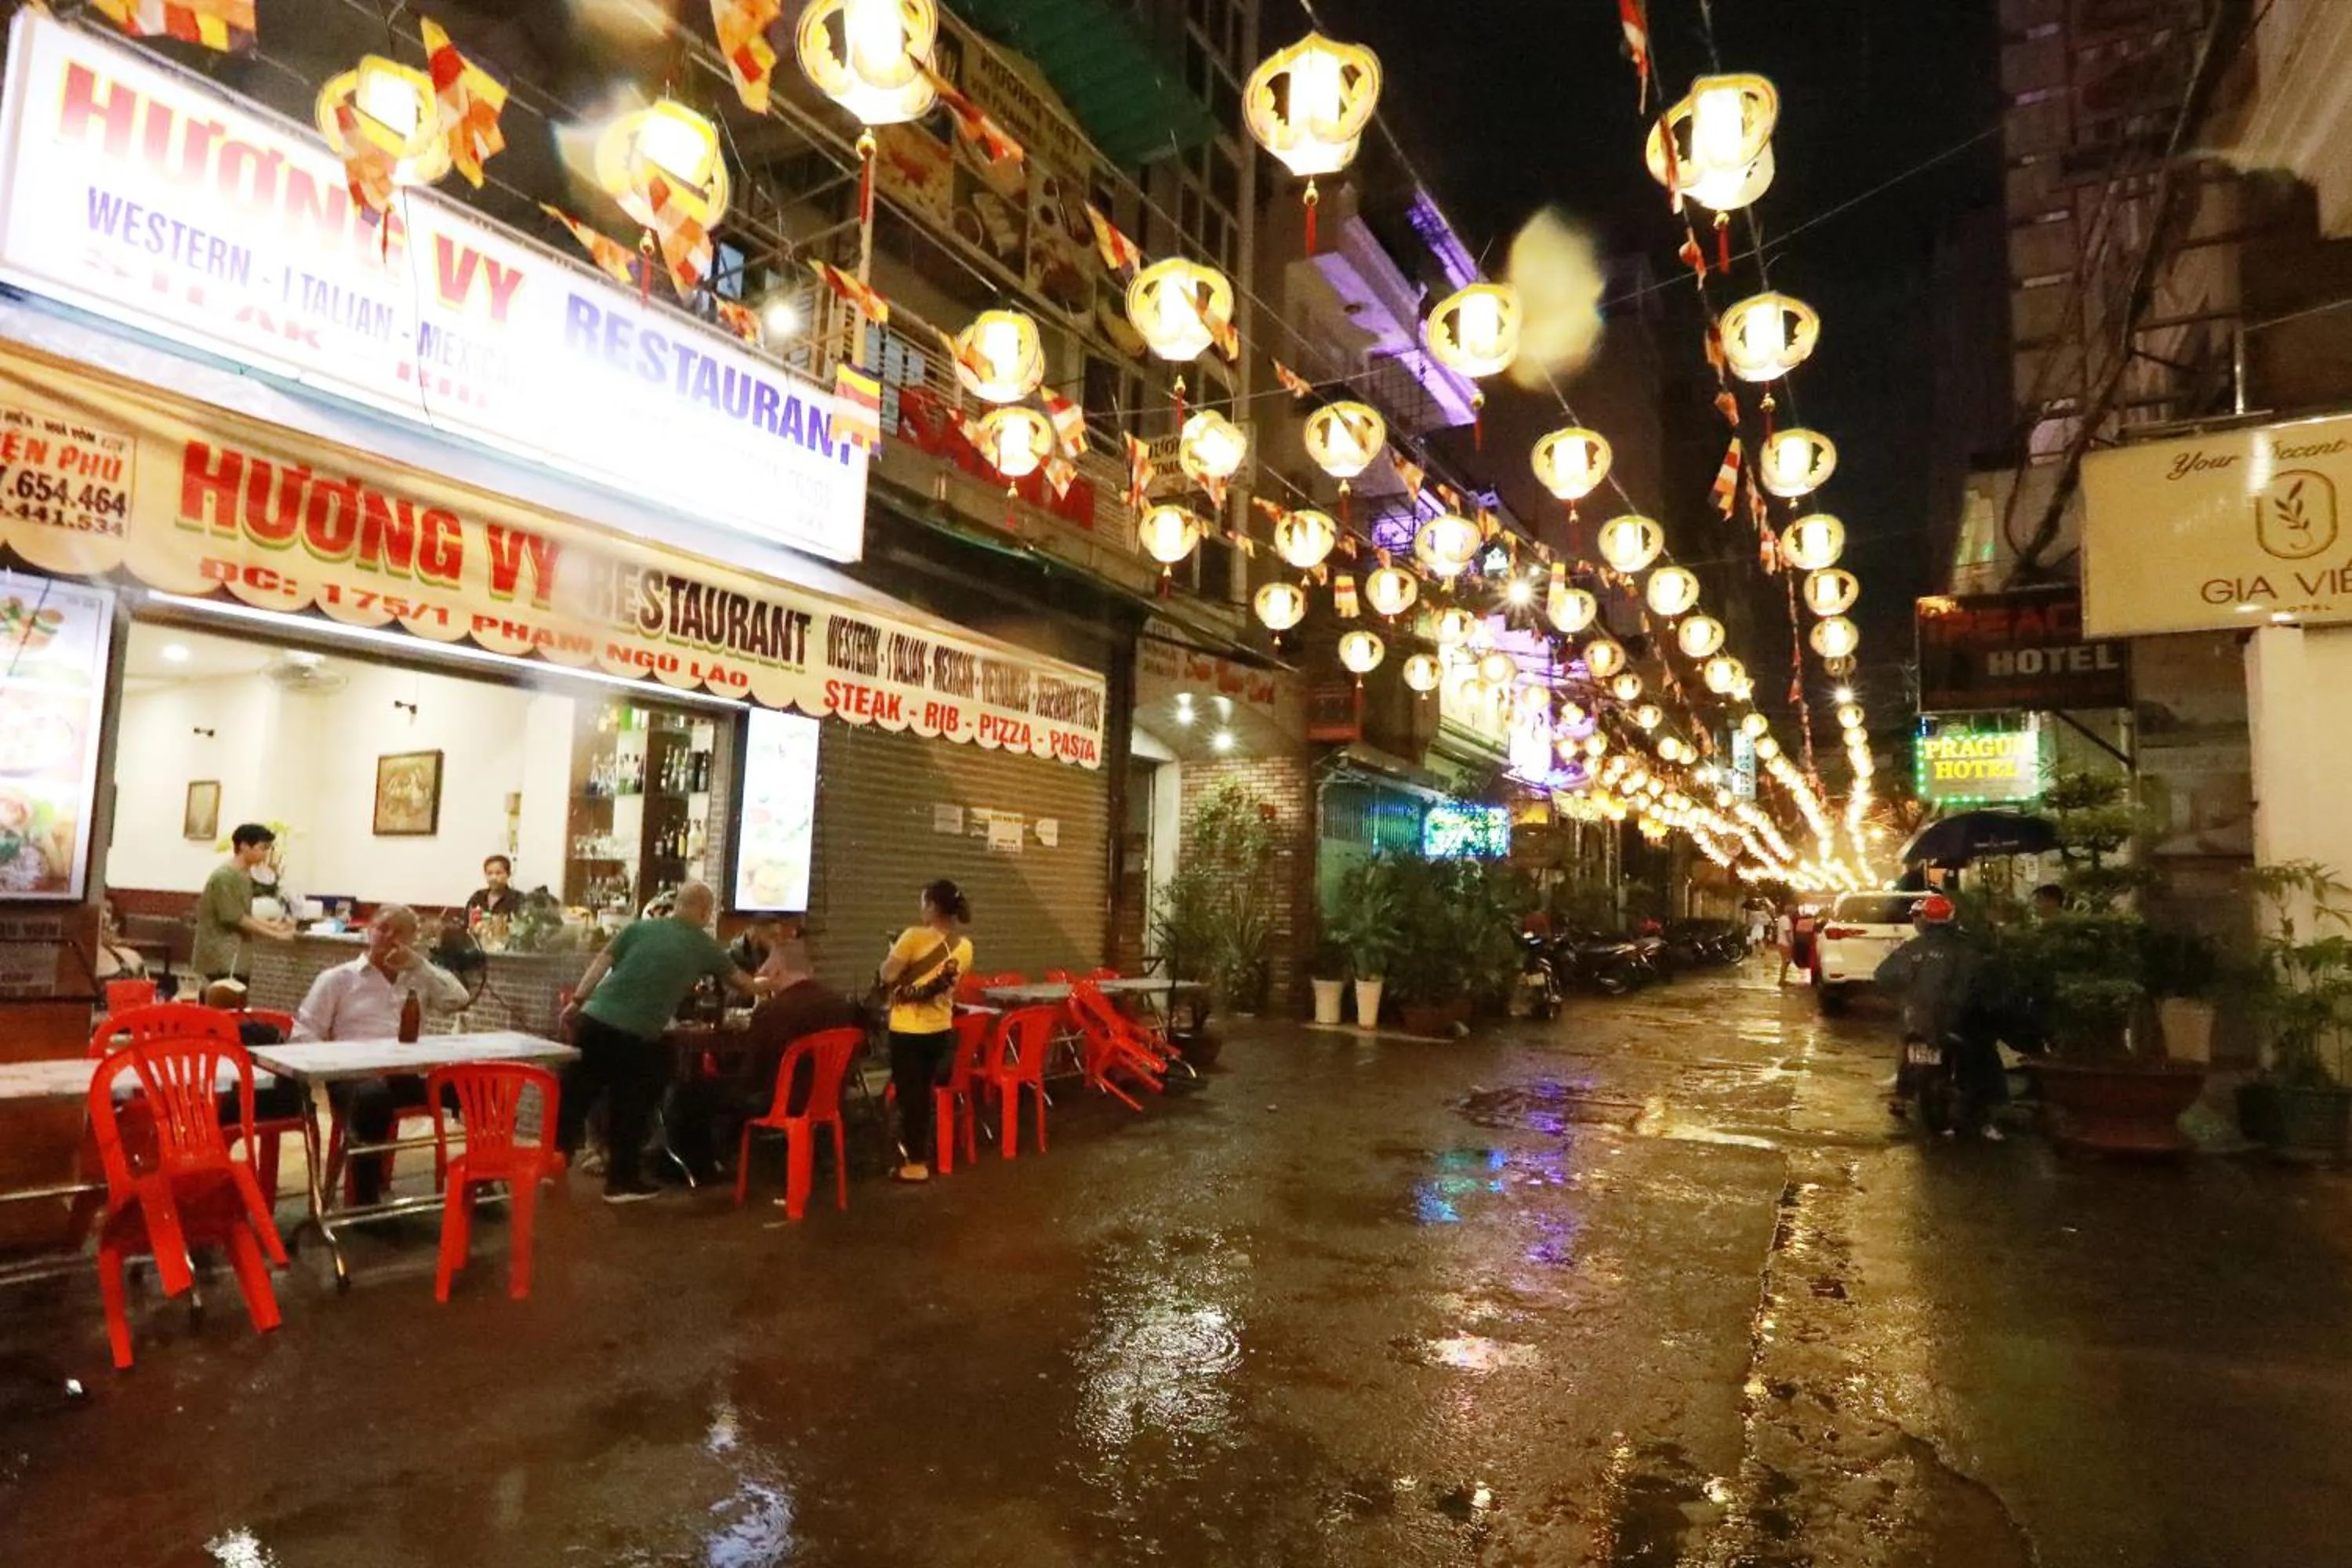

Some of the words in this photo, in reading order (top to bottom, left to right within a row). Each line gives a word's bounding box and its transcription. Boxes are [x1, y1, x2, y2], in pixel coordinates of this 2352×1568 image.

[87, 185, 251, 286] WESTERN
[436, 233, 524, 320] VY
[2166, 451, 2240, 481] Your
[179, 440, 463, 584] HƯƠNG
[485, 523, 560, 606] VY
[588, 549, 813, 669] RESTAURANT
[321, 583, 449, 626] 175/1
[2201, 576, 2278, 604] GIA
[826, 614, 880, 677] WESTERN
[1987, 643, 2120, 676] HOTEL
[823, 679, 902, 722] STEAK
[925, 701, 960, 733] RIB
[979, 713, 1032, 750] PIZZA
[1050, 729, 1096, 762] PASTA
[1924, 737, 2024, 759] PRAGU
[1933, 759, 2020, 779] HOTEL
